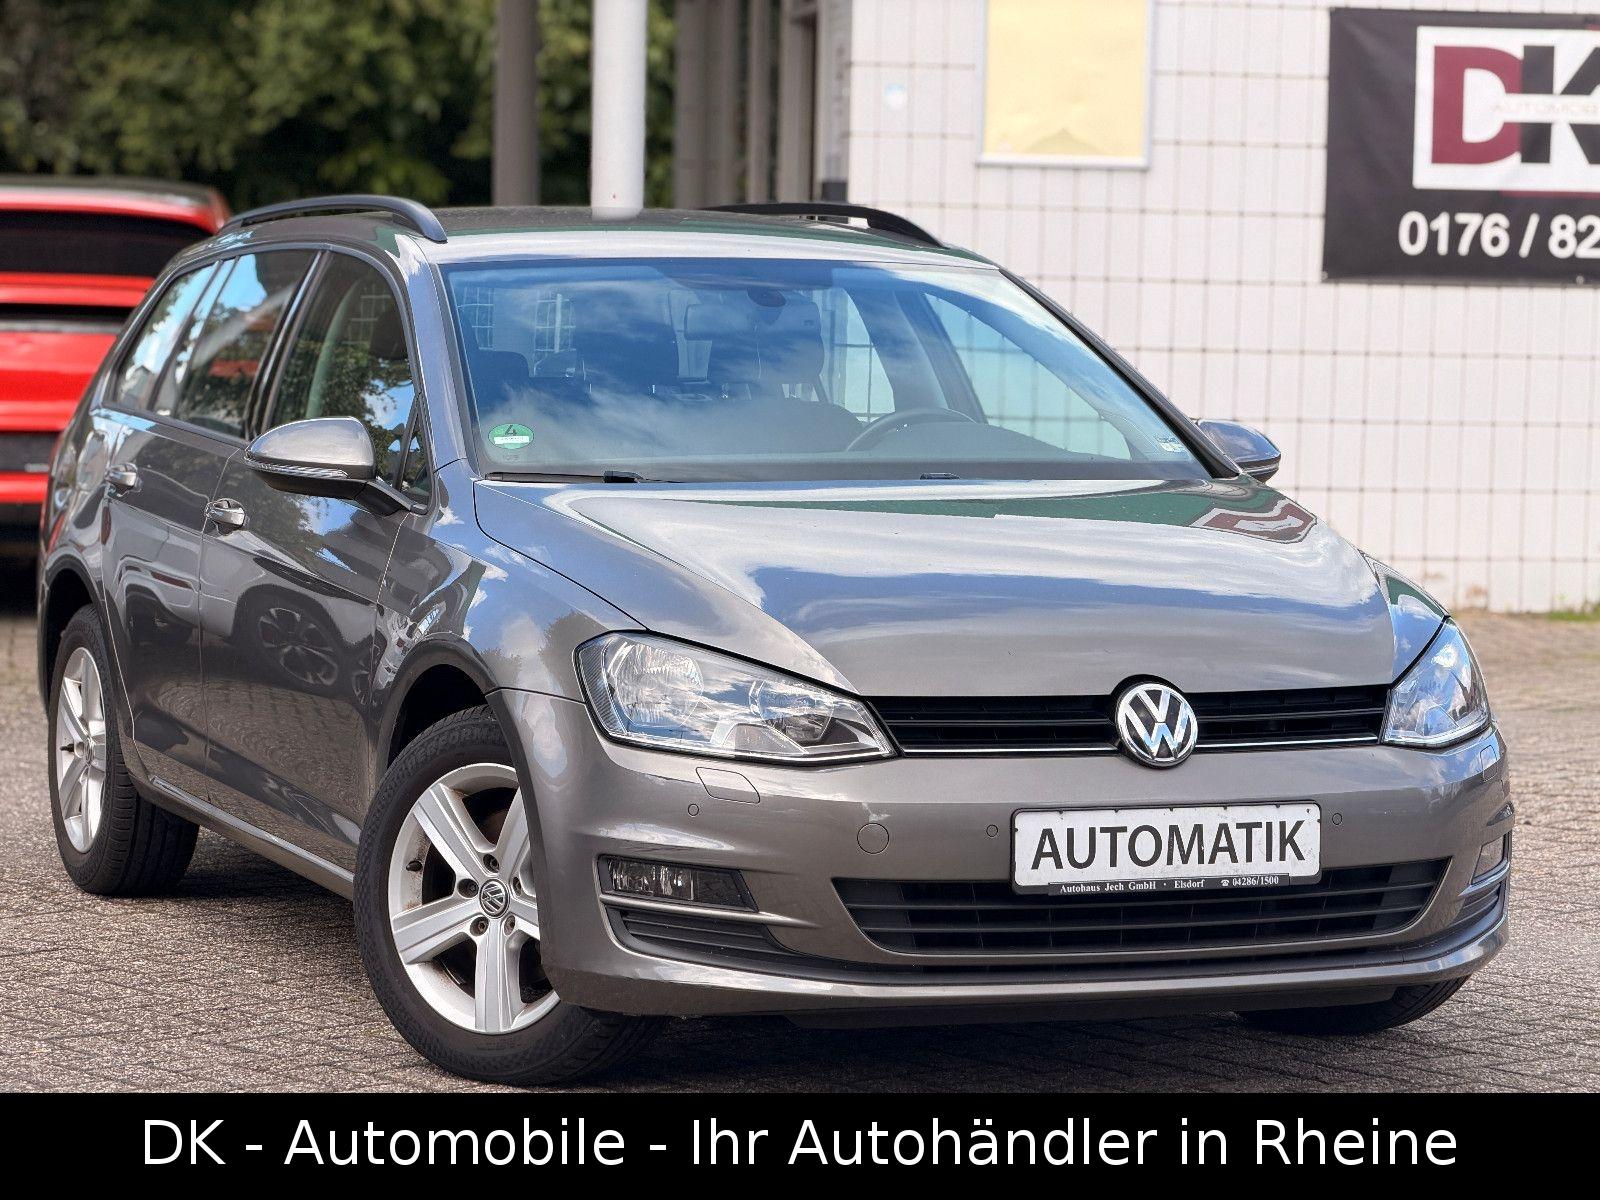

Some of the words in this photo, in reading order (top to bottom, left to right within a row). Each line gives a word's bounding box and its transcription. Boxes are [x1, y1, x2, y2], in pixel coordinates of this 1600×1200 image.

[1398, 210, 1510, 257] 0176
[1548, 213, 1600, 259] 82
[1117, 684, 1197, 765] VW
[1030, 819, 1306, 871] AUTOMATIK
[1060, 883, 1101, 894] Autohaus
[1104, 881, 1125, 892] Jech
[1128, 880, 1157, 891] GmbH
